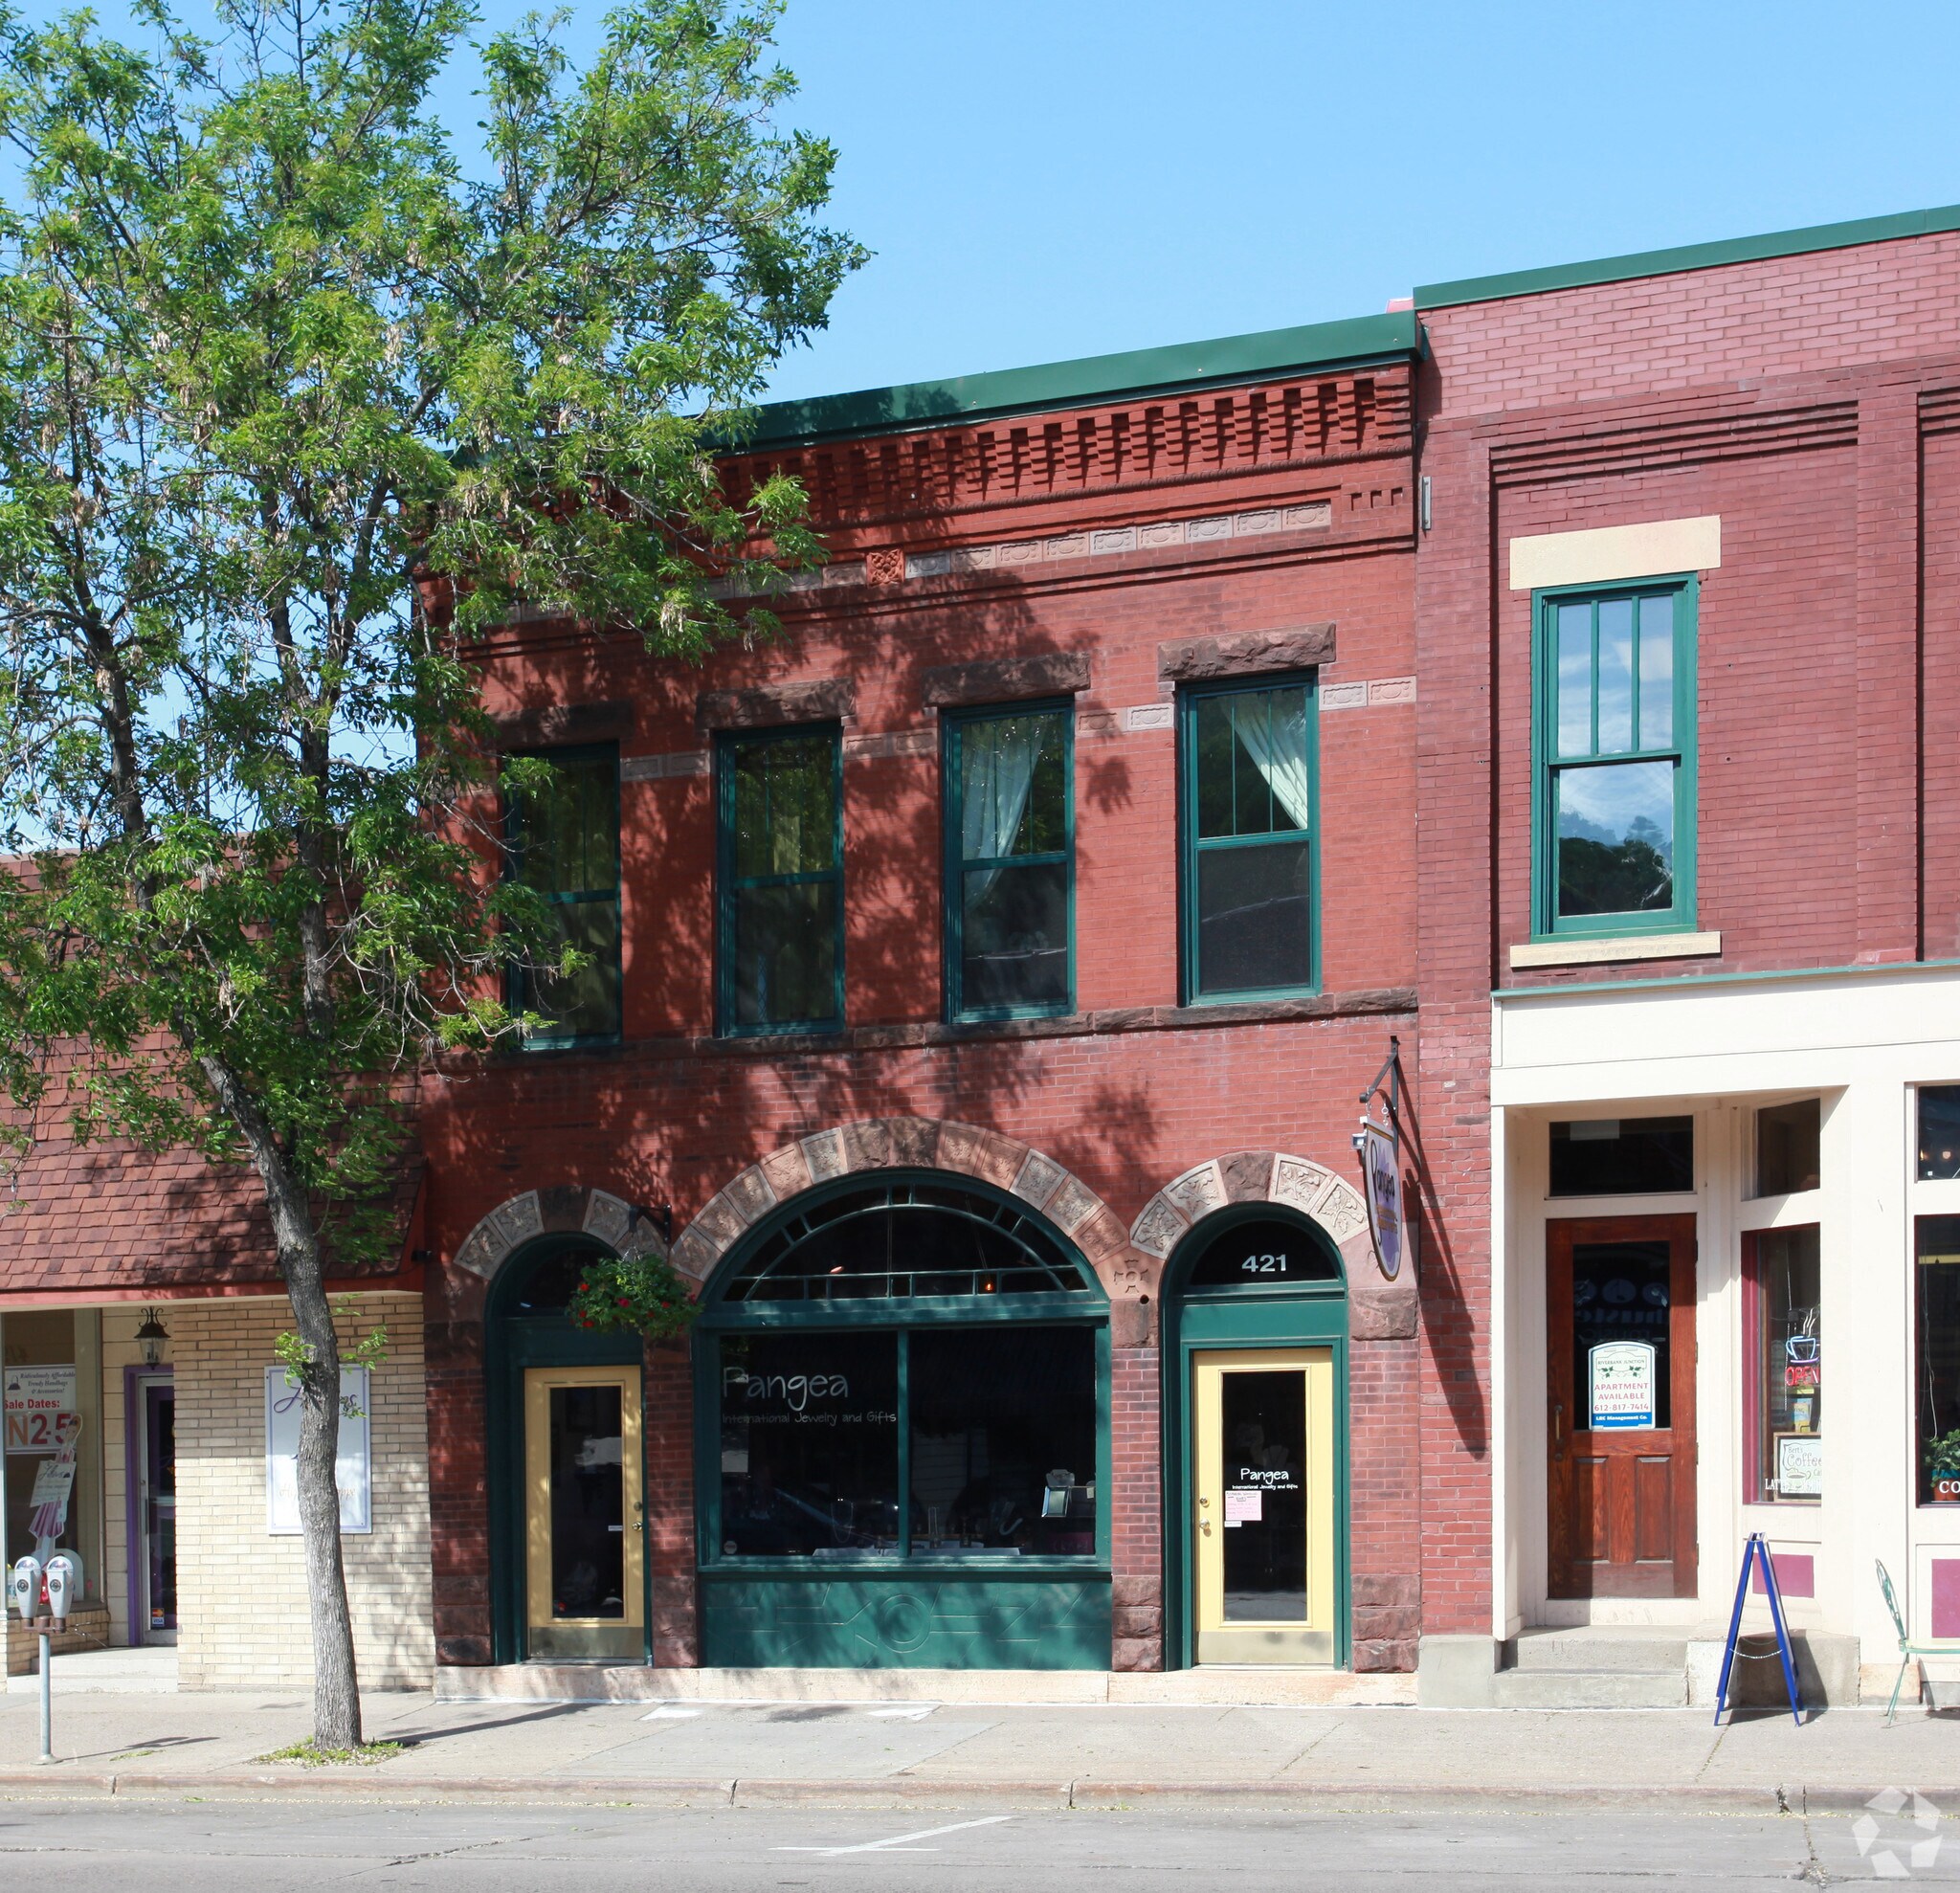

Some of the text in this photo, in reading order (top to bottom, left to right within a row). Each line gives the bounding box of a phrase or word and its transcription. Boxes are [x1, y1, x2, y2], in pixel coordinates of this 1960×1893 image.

[1241, 1254, 1286, 1272] 421
[1785, 1366, 1820, 1386] OPEN
[723, 1367, 849, 1412] Pangea
[1593, 1382, 1649, 1392] APARTMENT
[27, 1398, 60, 1409] Dates:
[723, 1412, 897, 1426] International Jewelry and Gifts
[1240, 1468, 1289, 1484] Pangea
